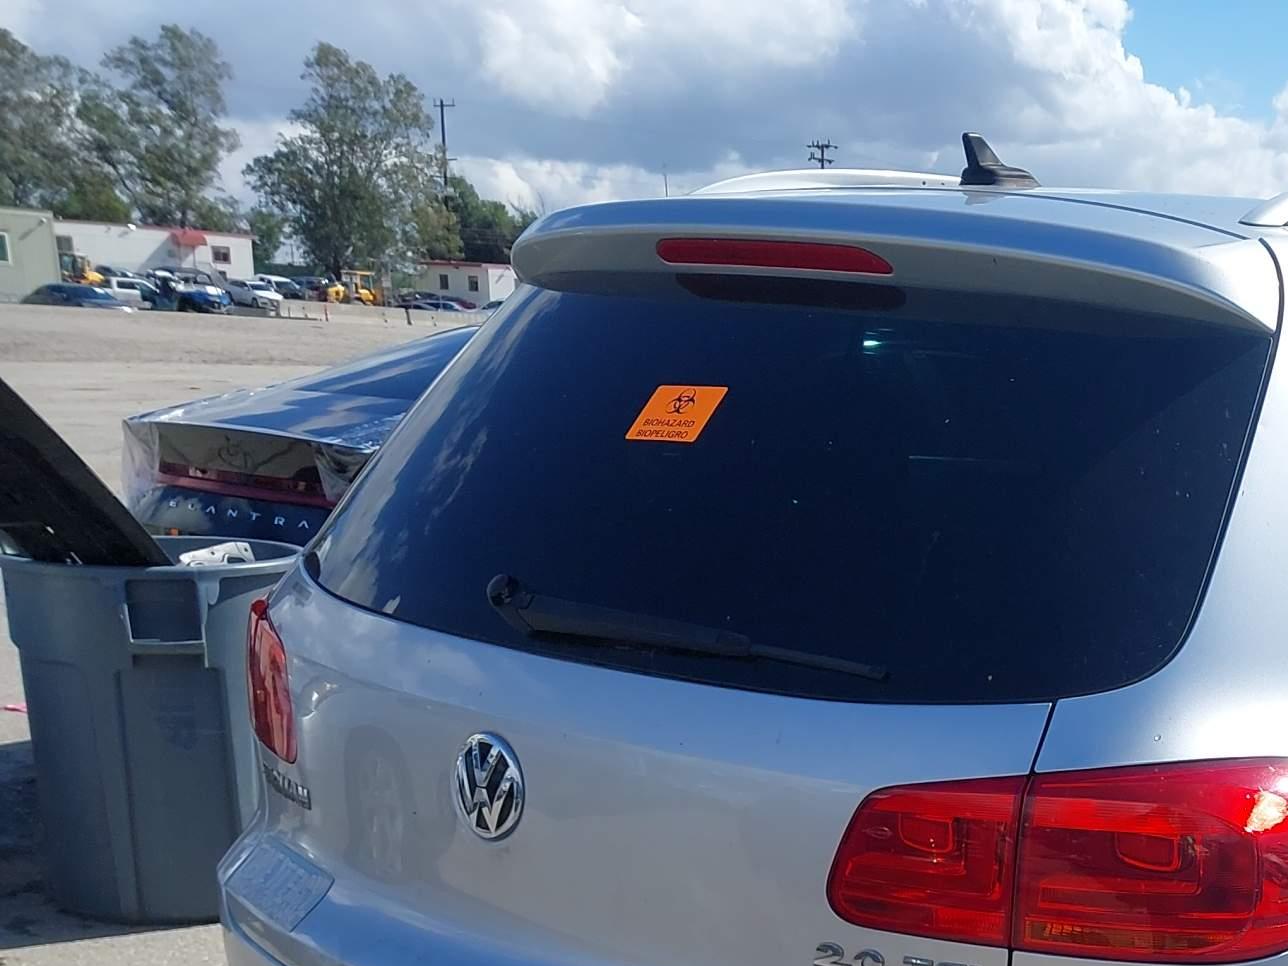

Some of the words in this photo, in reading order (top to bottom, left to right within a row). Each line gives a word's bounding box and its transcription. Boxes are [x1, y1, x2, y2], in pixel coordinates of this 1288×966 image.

[642, 418, 695, 428] BIOHAZARD
[635, 429, 688, 439] BIOPELIGRO
[168, 499, 310, 529] ELANTRA
